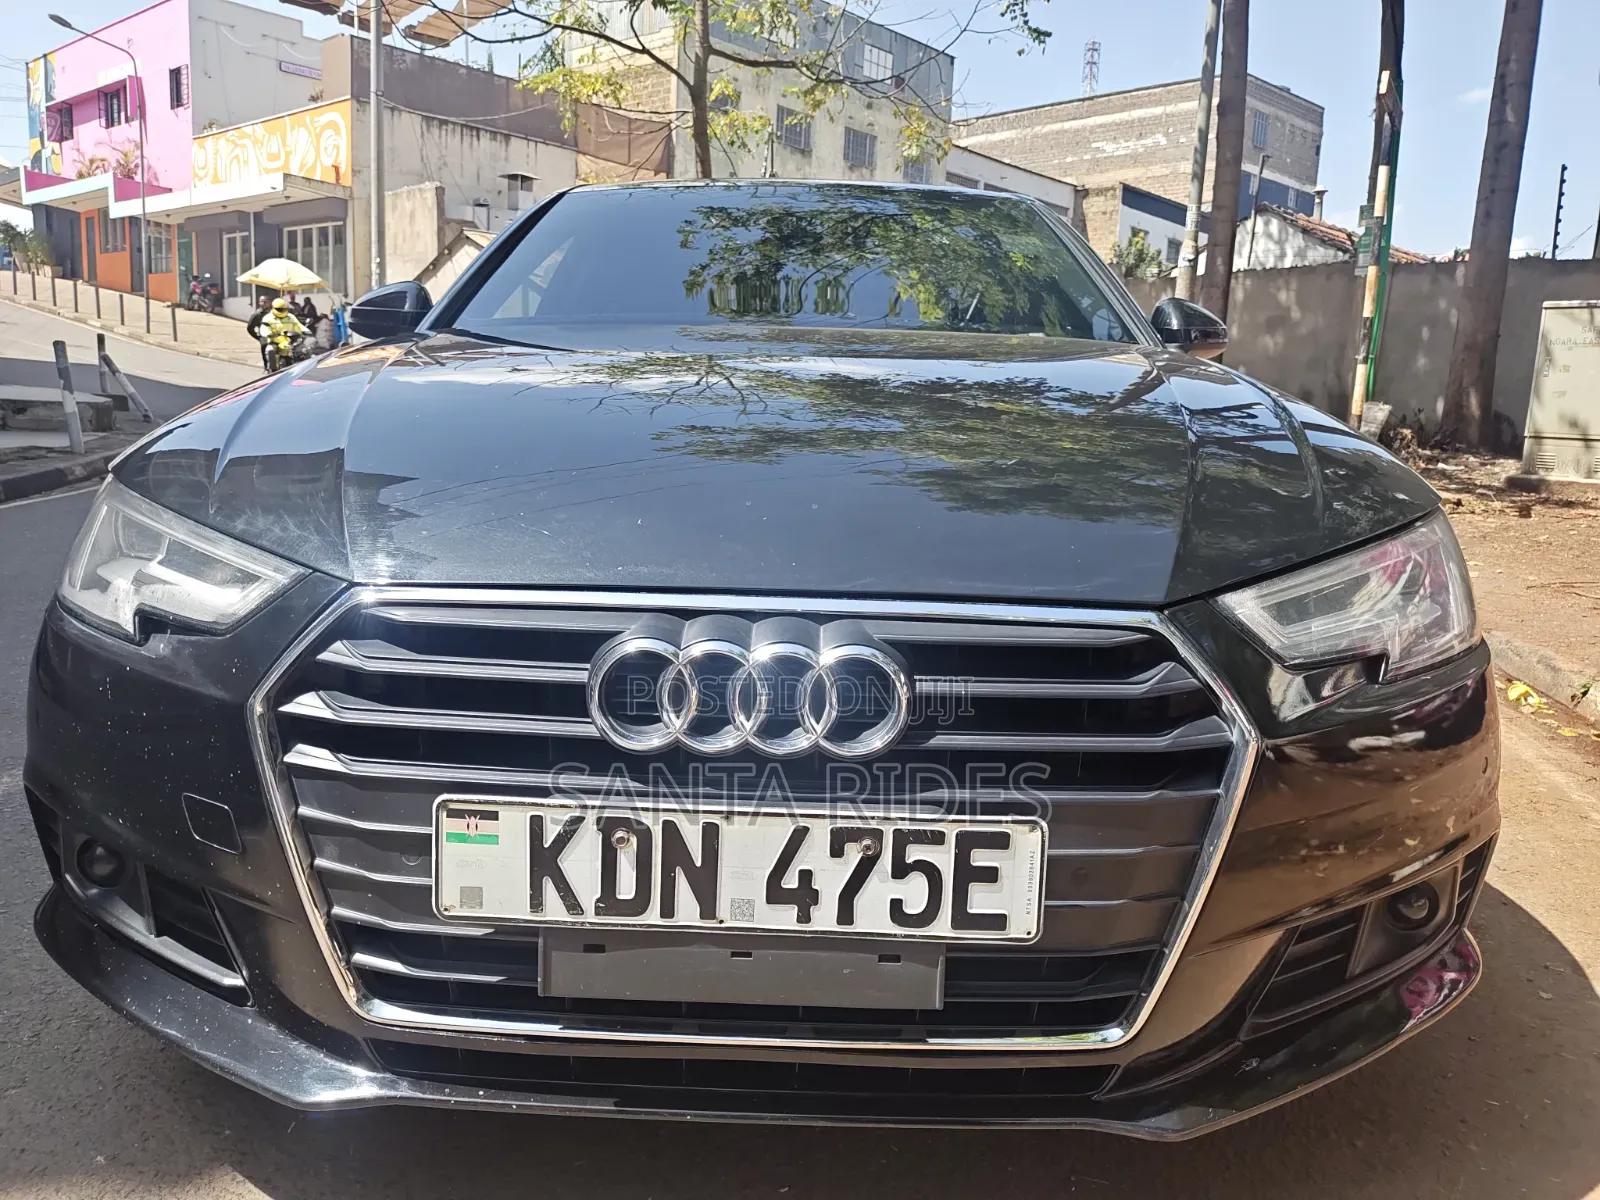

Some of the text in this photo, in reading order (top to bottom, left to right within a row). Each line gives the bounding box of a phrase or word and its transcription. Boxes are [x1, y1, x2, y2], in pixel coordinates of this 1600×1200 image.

[1549, 337, 1578, 347] NGARA
[528, 813, 1012, 932] KDN 475E
